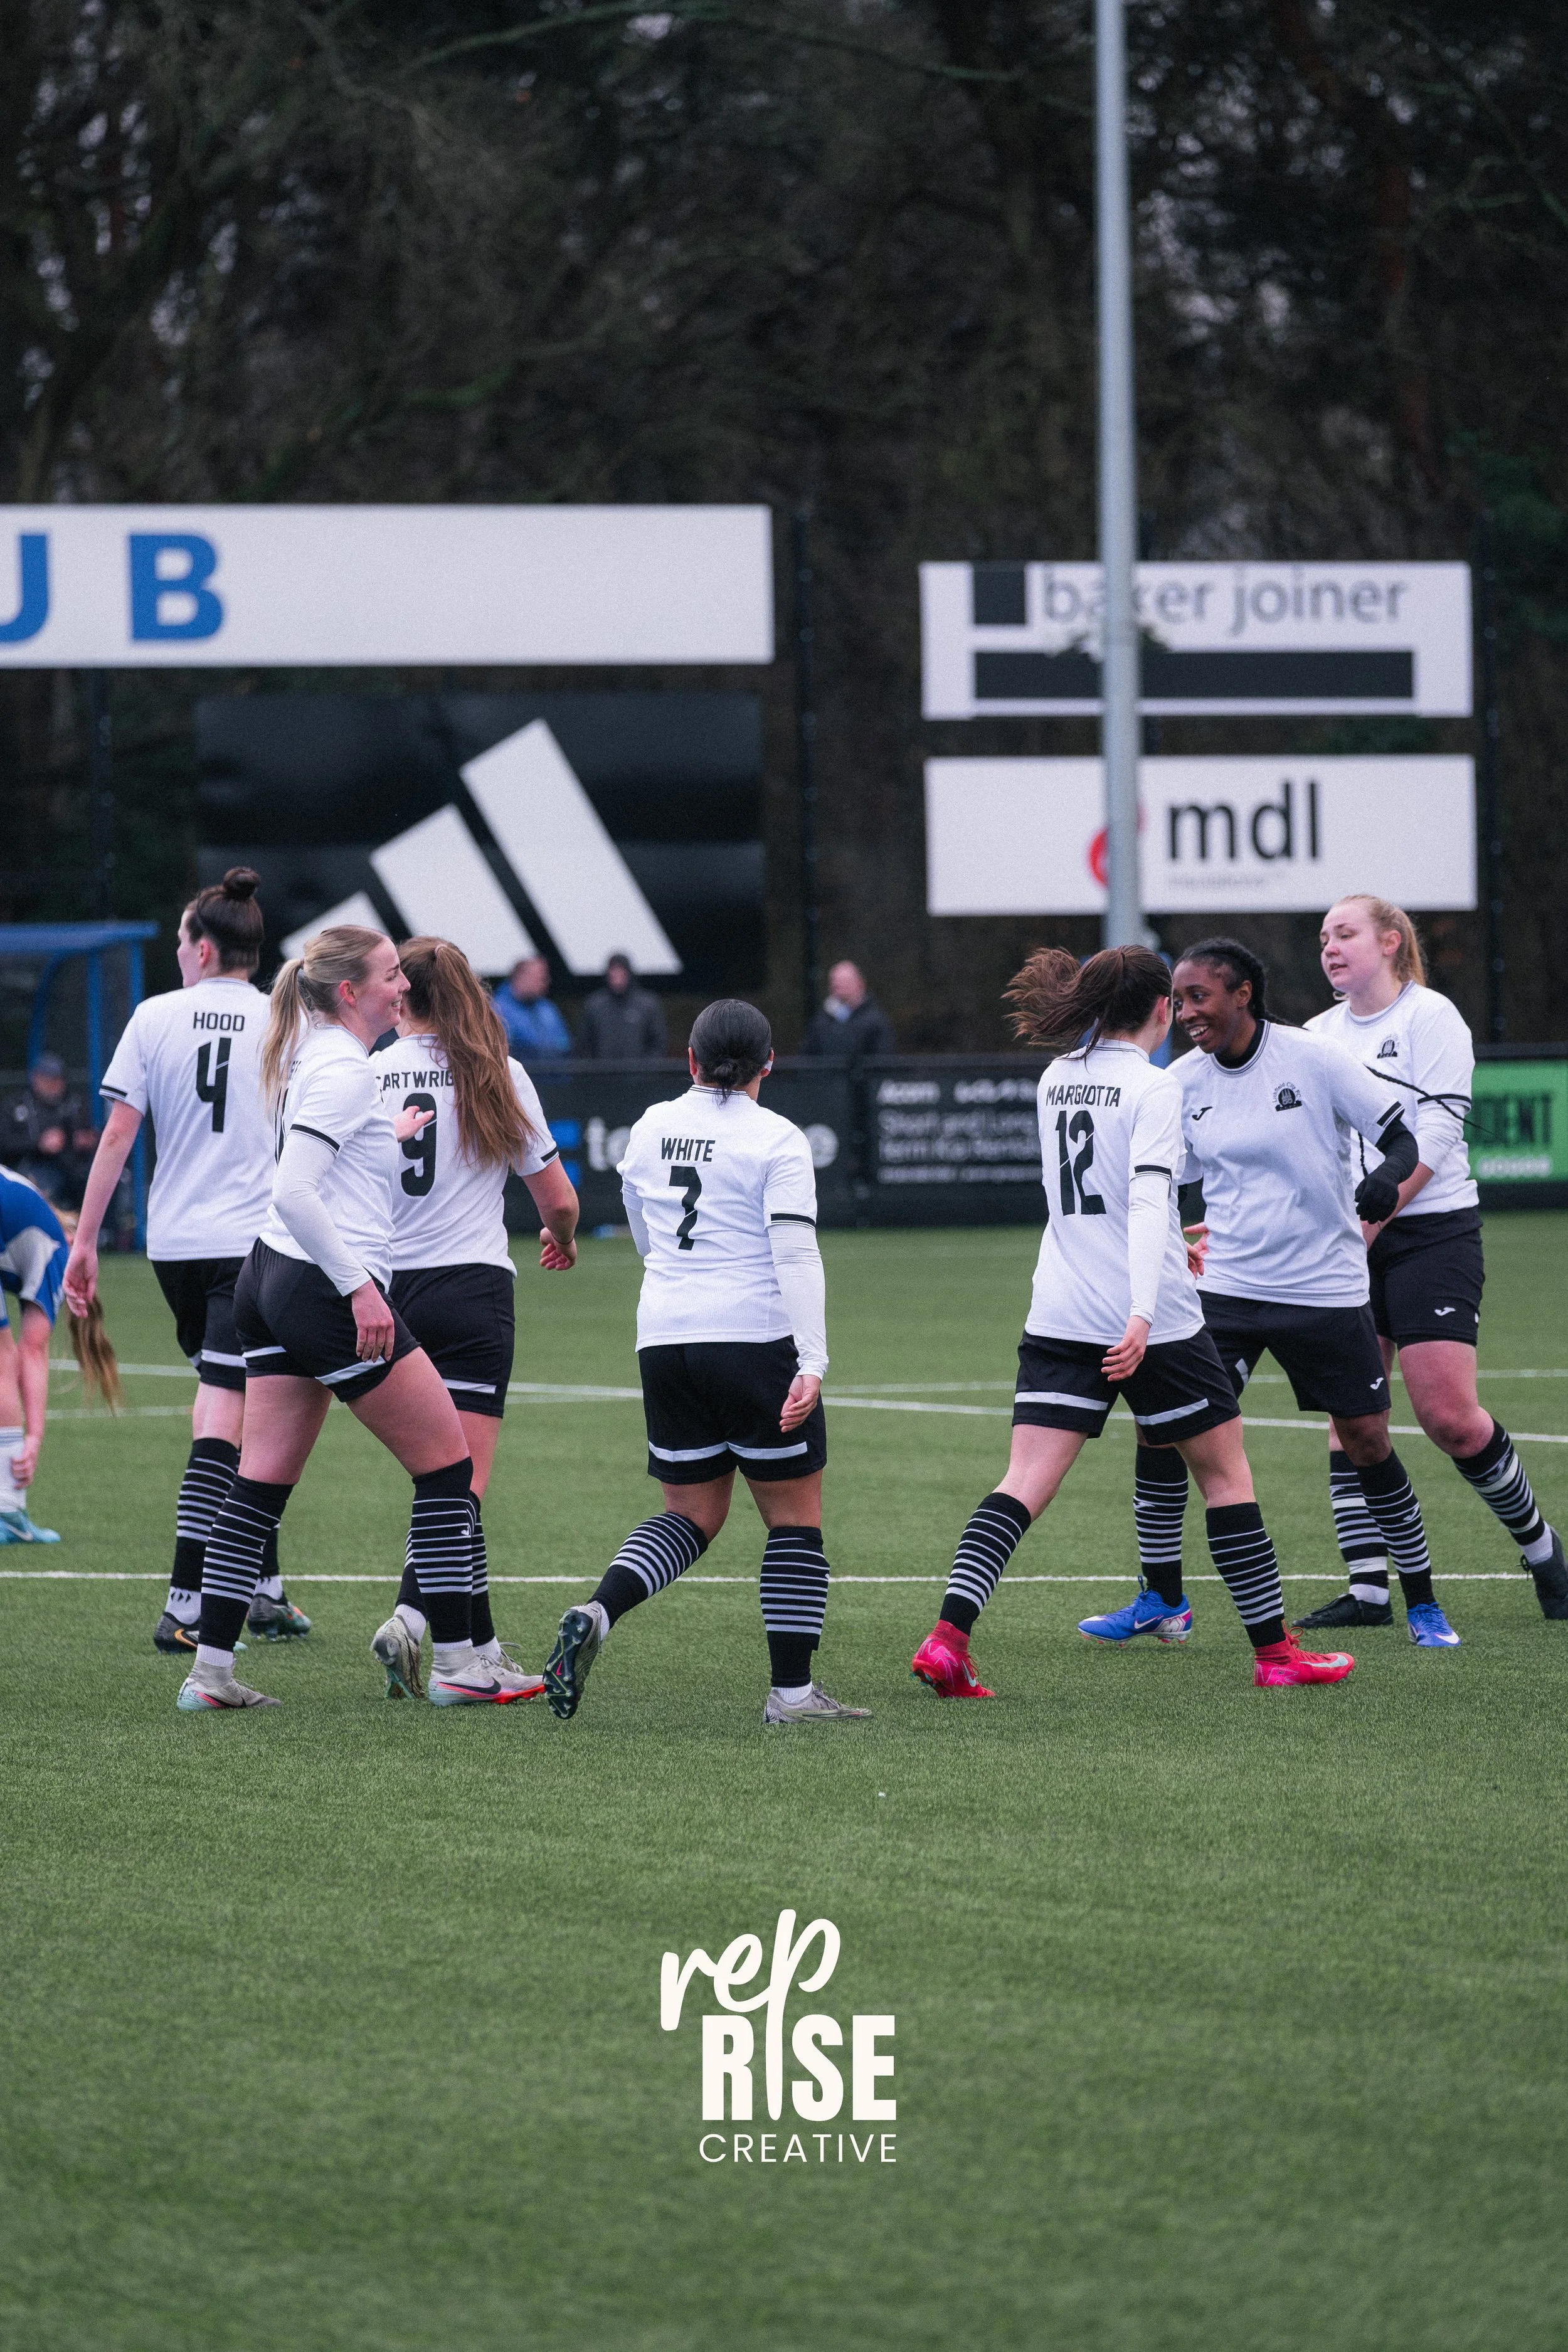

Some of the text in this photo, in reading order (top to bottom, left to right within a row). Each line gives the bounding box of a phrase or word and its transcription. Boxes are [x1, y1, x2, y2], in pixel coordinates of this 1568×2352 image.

[1231, 563, 1406, 635] joiner
[1168, 780, 1319, 862] mdl
[193, 1012, 245, 1032] HOOD
[196, 1037, 231, 1132] 4
[376, 1069, 455, 1091] ARTWRIG
[1046, 1084, 1121, 1108] MARGIOTTA
[401, 1093, 437, 1197] 9
[661, 1137, 716, 1162] WHITE
[1055, 1110, 1107, 1216] 12
[669, 1165, 702, 1251] 7
